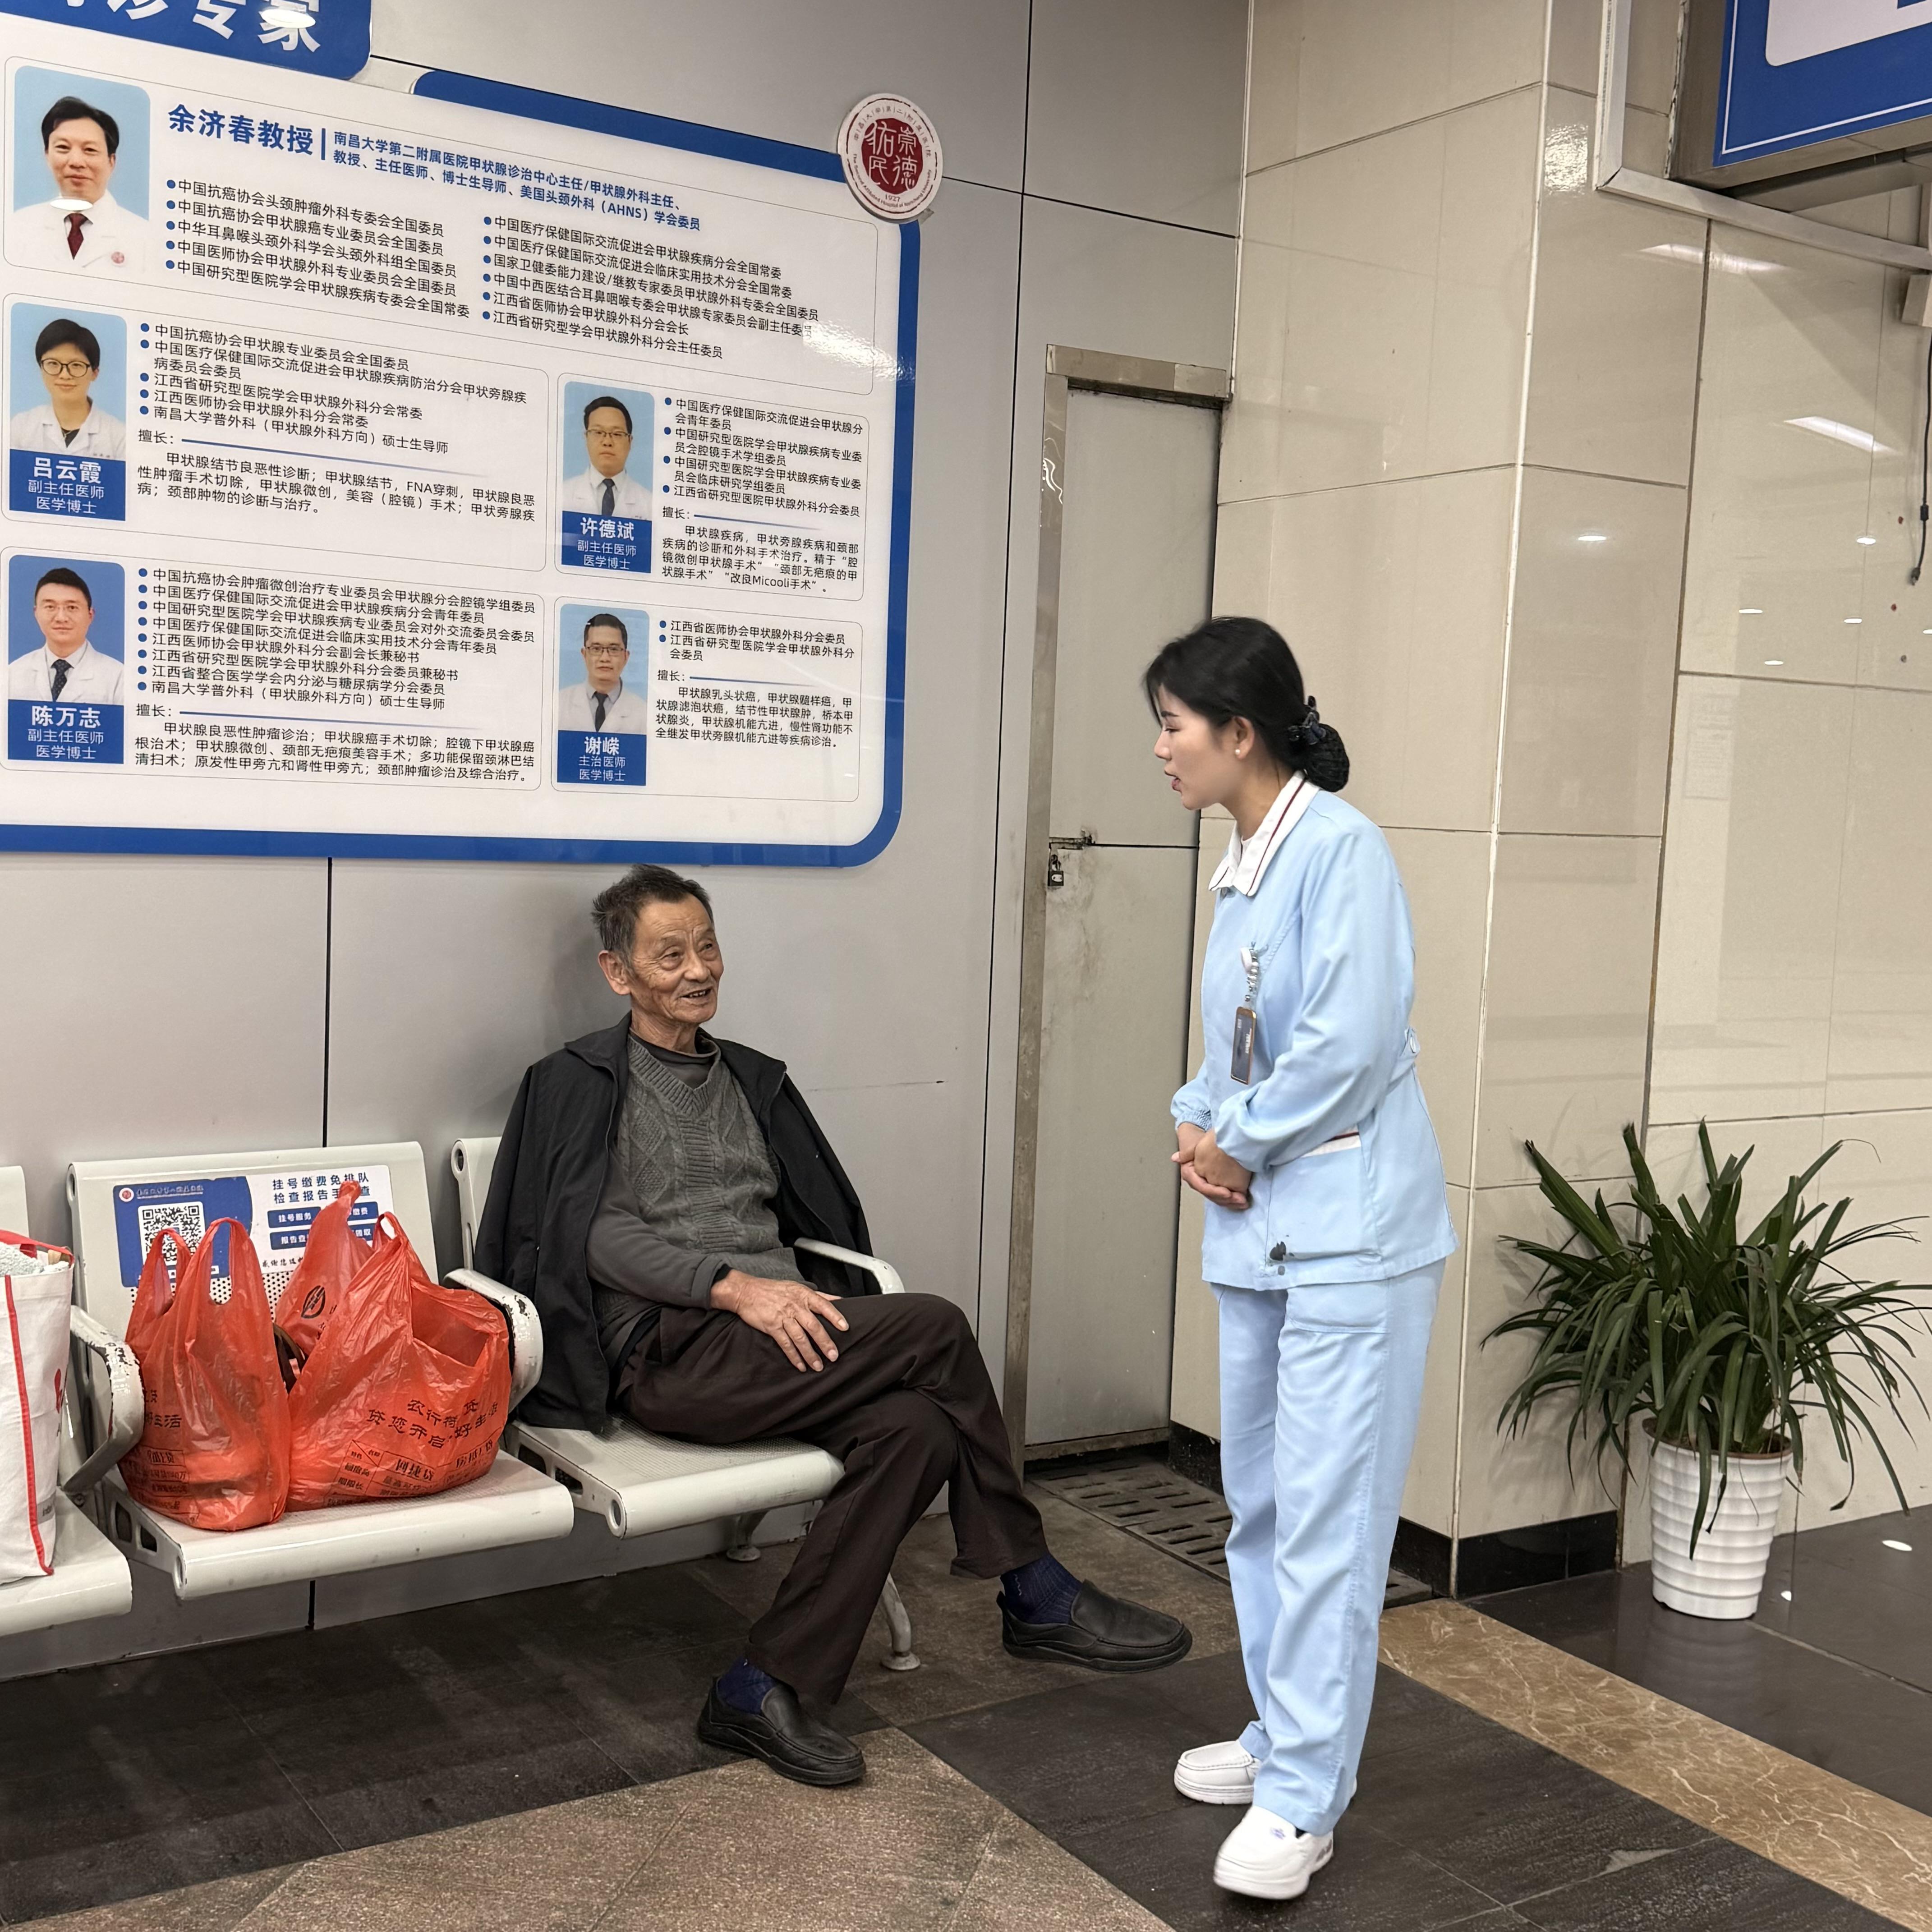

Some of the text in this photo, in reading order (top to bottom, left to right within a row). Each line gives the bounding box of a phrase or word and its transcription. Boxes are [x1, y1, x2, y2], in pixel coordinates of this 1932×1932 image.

[168, 104, 313, 155] 余济春教授
[179, 179, 444, 237] 中国抗癌协会头颈肿瘤外科专委会全国委员
[885, 194, 901, 202] 1927
[179, 199, 443, 256] 中国抗癌协会甲状腺癌专业委员会全国委员
[179, 220, 456, 278] 中华耳鼻喉头颈外科学会头颈外科组全国委员
[495, 216, 781, 280] 中国医疗保健国际交流促进会甲状腺疾病分会全国常委
[178, 240, 456, 297] 中国医师协会甲状腺外科专业委员会全国委员
[495, 235, 791, 299] 中国医疗保健国际交流促进会临床实用技术分会全国常委
[178, 260, 469, 318] 中国研究型医院学会甲状腺疾病专委会全国常委
[494, 254, 819, 322] 国家卫健委能力建设/继教专家委员甲状腺外科专委会全国委员
[494, 291, 689, 335] 江西省医师协会甲状腺外科分会会长
[156, 324, 409, 372] 中国抗癌协会甲状腺专业委员会全国委员
[493, 310, 722, 359] 江西省研究型学会甲状腺外科分会主任委员
[154, 357, 241, 380] 病委员会委员
[156, 340, 526, 404] 中国医疗保健国际交流促进会甲状腺疾病防治分会甲状旁腺疾
[154, 373, 422, 420] 江西省研究型医院学会甲状腺外科分会常委
[154, 390, 368, 428] 江西医师协会甲状腺外科分会常委
[154, 406, 448, 453] 南昌大学普外科（甲状腺外科方向）硕士生导师
[676, 399, 863, 434] 中国医疗保健国际交流促进会甲状腺分
[676, 413, 731, 431] 会青年委员
[675, 442, 786, 466] 员会腔镜手术学组委员
[676, 428, 862, 462] 中国研究型医院学会甲状腺疾病专业委
[34, 457, 101, 484] 吕云霞
[674, 470, 785, 494] 员会临床研究学组委员
[675, 456, 861, 490] 中国研究型医院学会甲状腺疾病专业委
[28, 479, 105, 500] 副主任医师
[674, 485, 860, 517] 江西省研究型医院甲状腺外科分会委员
[37, 497, 97, 514] 医学博士
[580, 517, 634, 541] 许德斌
[578, 540, 636, 557] 副主任医师
[584, 555, 630, 570] 医学博士
[153, 569, 535, 613] 中国抗癌协会肿瘤微创治疗专业委员会甲状腺分会腔镜学组委员
[153, 585, 484, 624] 中国医疗保健国际交流促进会甲状腺疾病分会青年委员
[153, 601, 534, 642] 中国研究型医院学会甲状腺疾病专业委员会对外交流委员会委员
[153, 617, 497, 654] 中国医疗保健国际交流促进会临床实用技术分会青年委员
[671, 621, 845, 644] 江西省医师协会甲状腺外科分会委员
[152, 633, 419, 663] 江西医师协会甲状腺外科分会副会长兼秘书
[670, 649, 703, 661] 会委员
[671, 635, 854, 658] 江西省研究型医院学会甲状腺外科分
[152, 649, 458, 681] 江西省研究型医院学会甲状腺外科分会委员兼秘书
[152, 665, 445, 695] 江西省整合医学学会内分泌与糖尿病学分会委员
[152, 681, 445, 710] 南昌大学普外科（甲状腺外科方向）硕士生导师
[32, 705, 101, 728] 陈万志
[28, 728, 104, 745] 副主任医师
[37, 745, 96, 759] 医学博士
[584, 736, 619, 755] 谢嵘
[579, 755, 626, 768] 主治医师
[580, 769, 626, 782] 医学博士
[274, 1186, 370, 1204] 检查报告手查
[281, 1235, 309, 1245] 报告查
